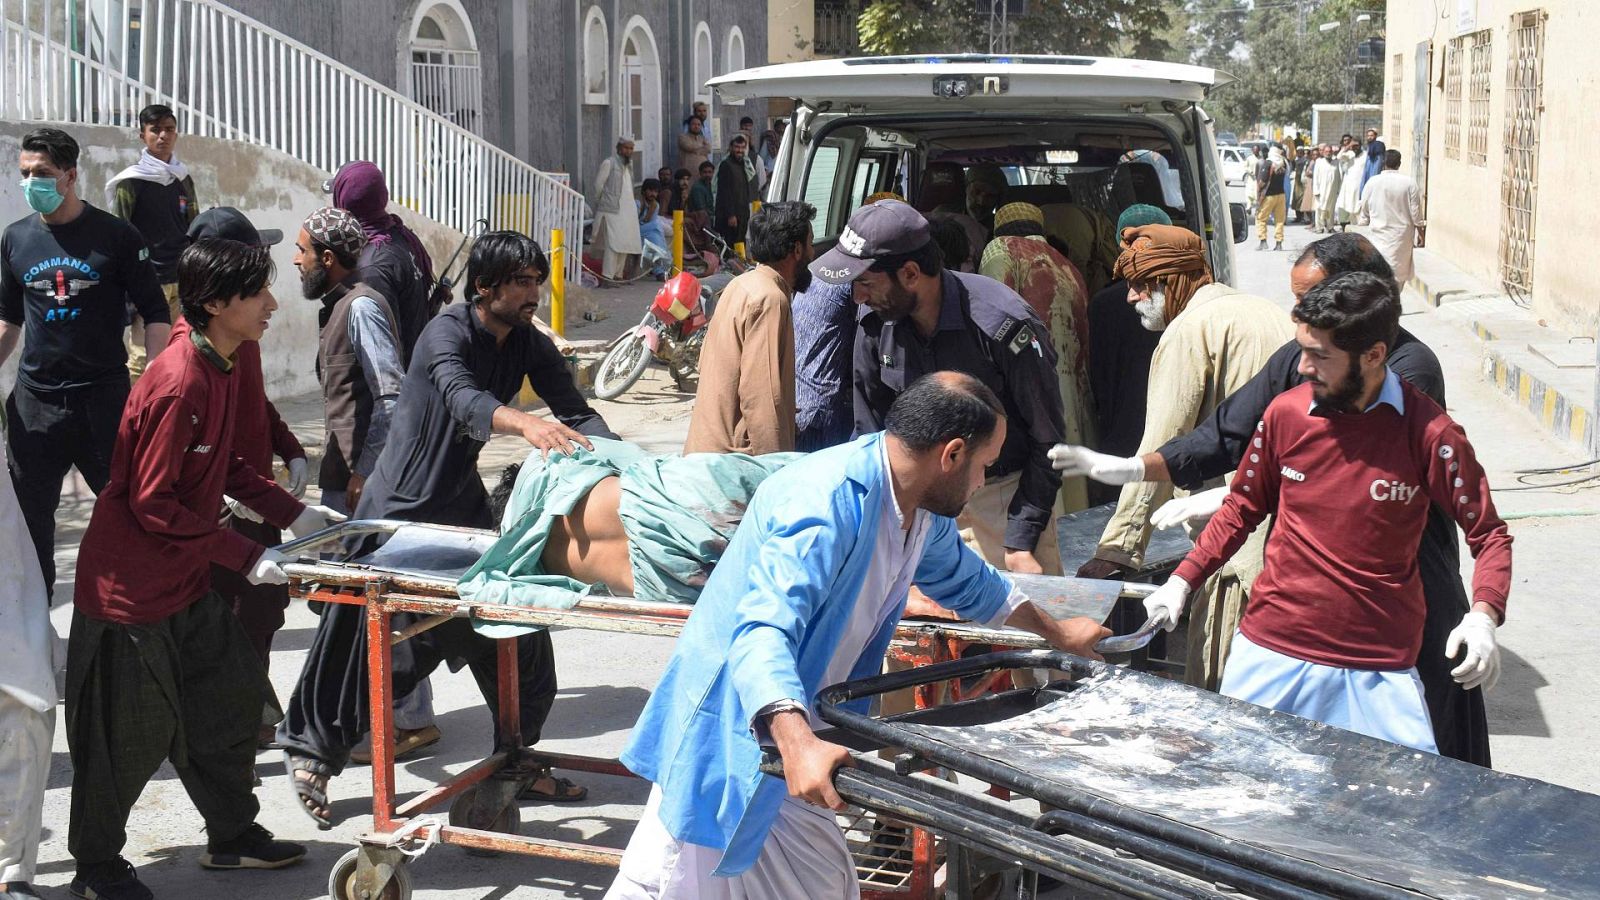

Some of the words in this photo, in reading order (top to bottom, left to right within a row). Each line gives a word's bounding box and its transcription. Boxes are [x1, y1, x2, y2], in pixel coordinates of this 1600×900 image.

[23, 257, 100, 282] COMMANDO
[819, 266, 851, 279] POLICE
[1280, 466, 1306, 482] JAKO
[1369, 479, 1420, 505] City
